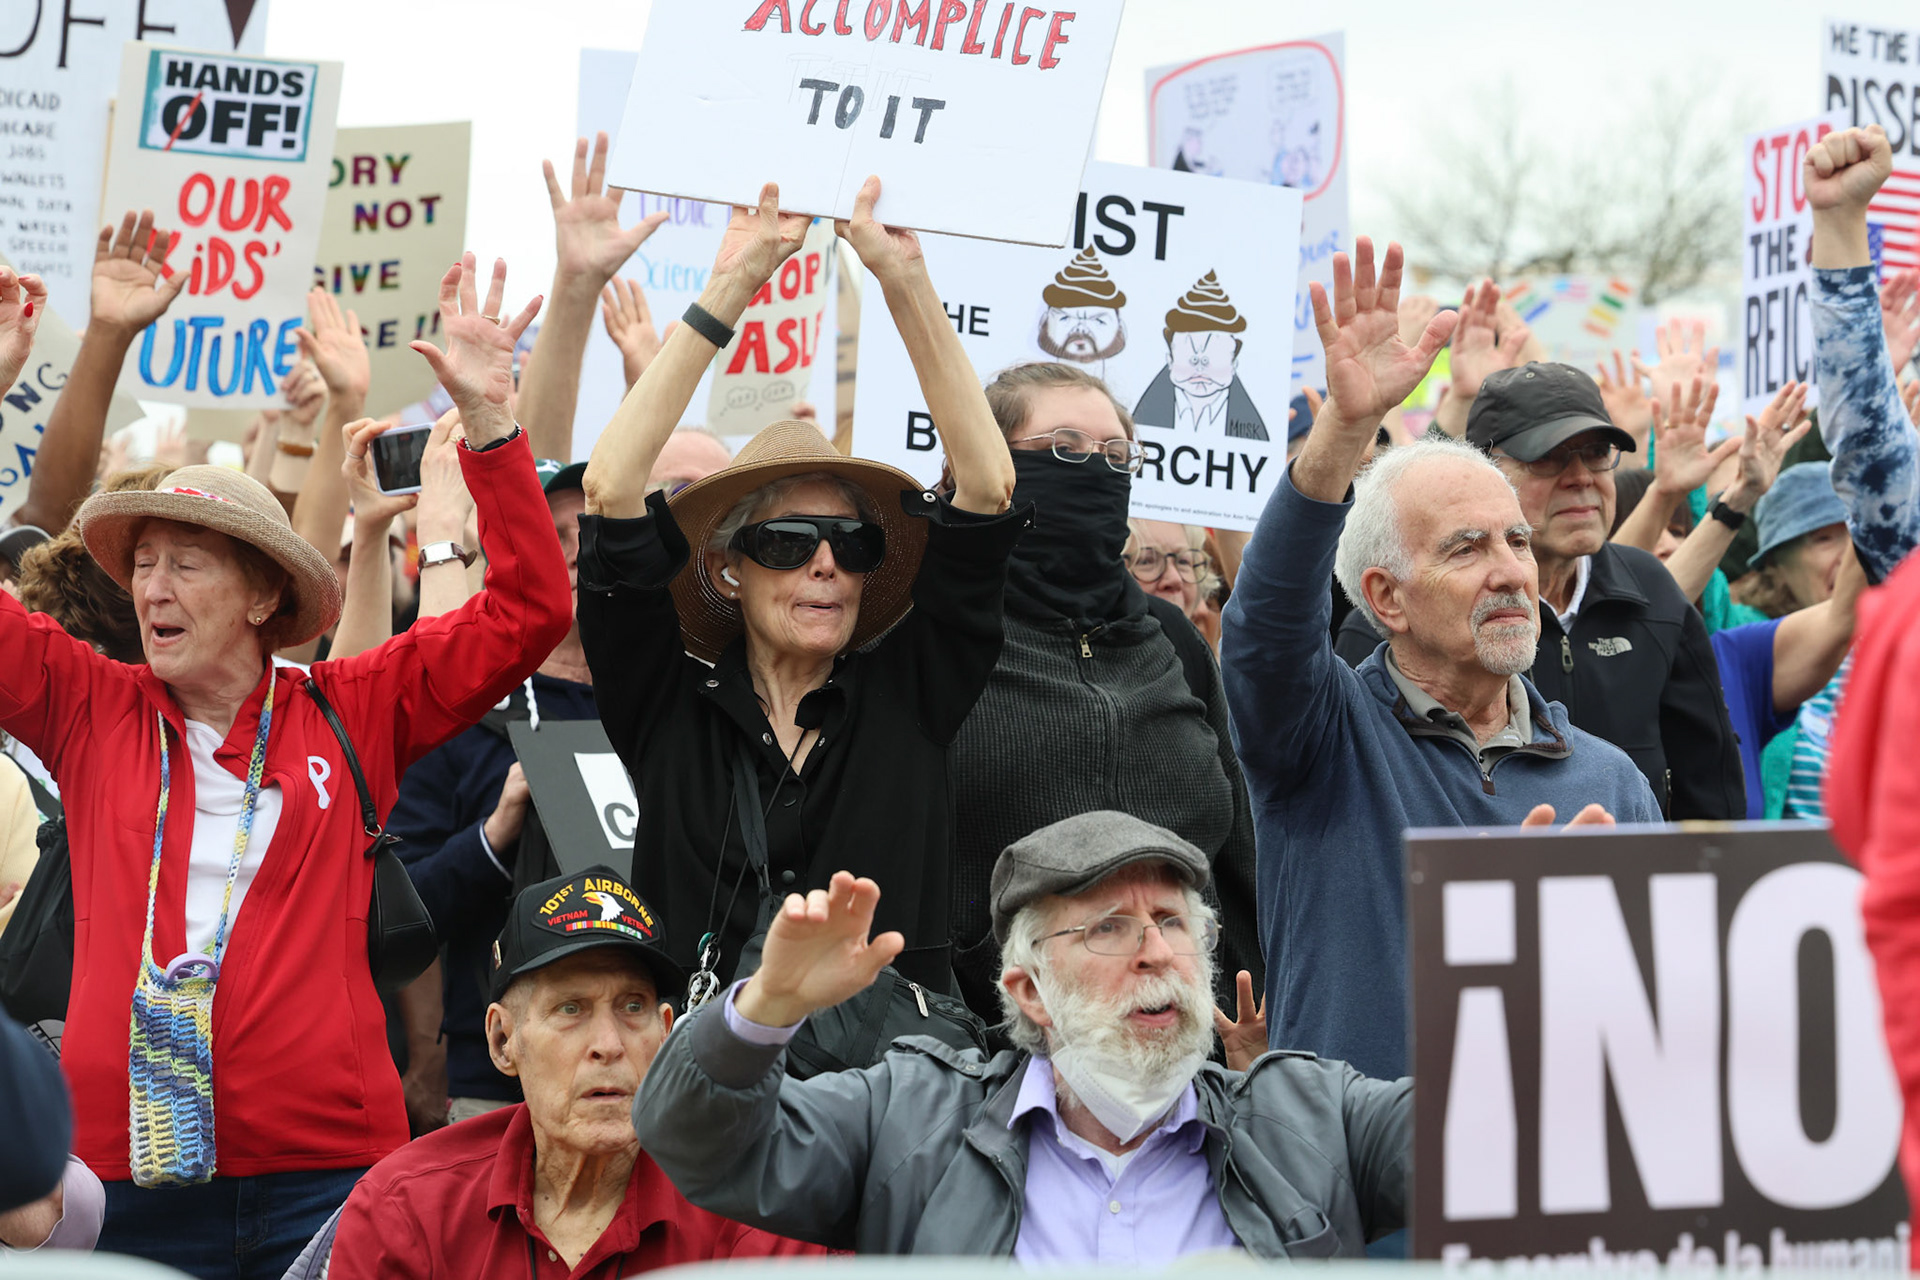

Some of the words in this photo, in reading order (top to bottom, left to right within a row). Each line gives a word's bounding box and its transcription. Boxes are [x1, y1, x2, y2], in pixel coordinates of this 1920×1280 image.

[741, 0, 1076, 70] ACCOMPLICE
[166, 60, 304, 98] HANDS
[161, 94, 302, 151] OFF!
[799, 78, 865, 130] TO
[879, 95, 946, 144] IT
[178, 172, 293, 234] OUR
[1751, 122, 1836, 223] STO
[354, 195, 442, 232] NOT
[1073, 191, 1185, 262] IST
[1750, 224, 1796, 279] THE
[139, 316, 303, 396] UTURE
[725, 311, 823, 375] ASL
[1745, 281, 1817, 399] REIC
[1229, 419, 1261, 440] MUSK
[539, 884, 574, 915] 101ST
[584, 878, 654, 928] AIRBORNE
[547, 910, 589, 926] VIETNAM
